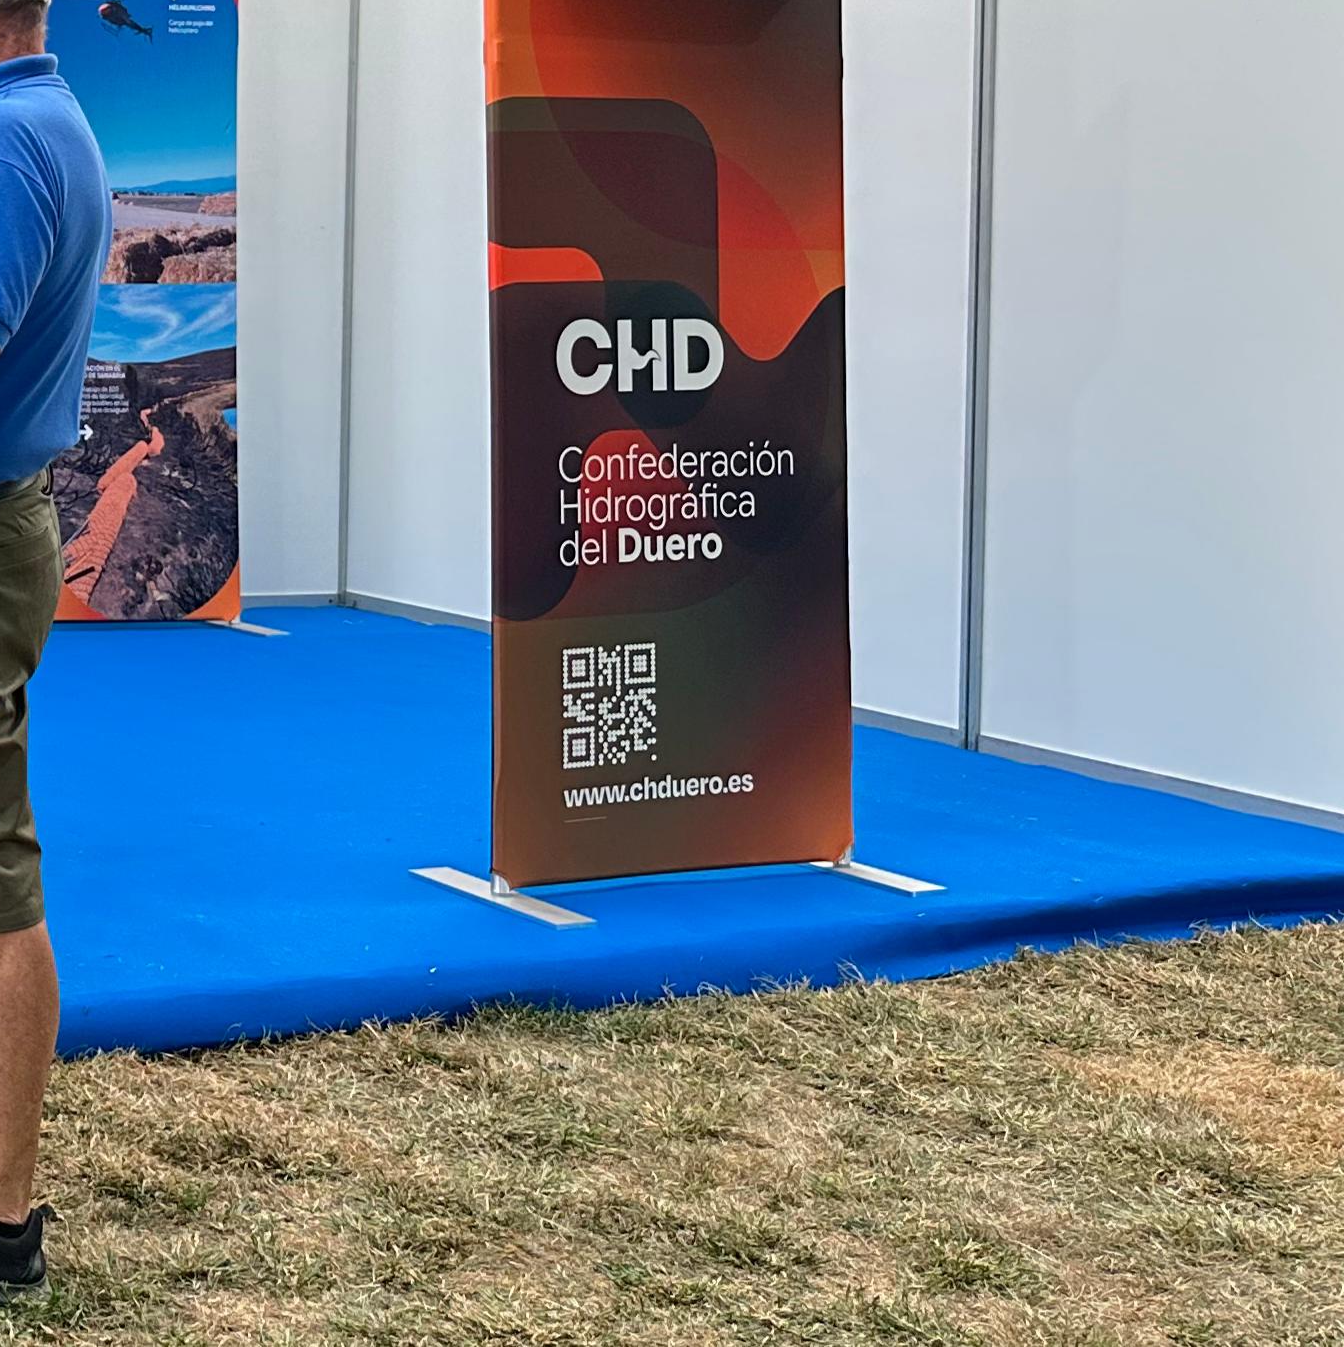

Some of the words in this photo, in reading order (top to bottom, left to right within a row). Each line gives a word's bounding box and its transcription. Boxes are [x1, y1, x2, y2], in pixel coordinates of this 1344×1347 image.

[556, 317, 724, 395] CHD
[559, 441, 794, 483] Confederación
[559, 482, 756, 530] Hidrográfica
[559, 530, 608, 567] del
[618, 527, 722, 564] Duero
[564, 771, 753, 809] www.chduero.es
